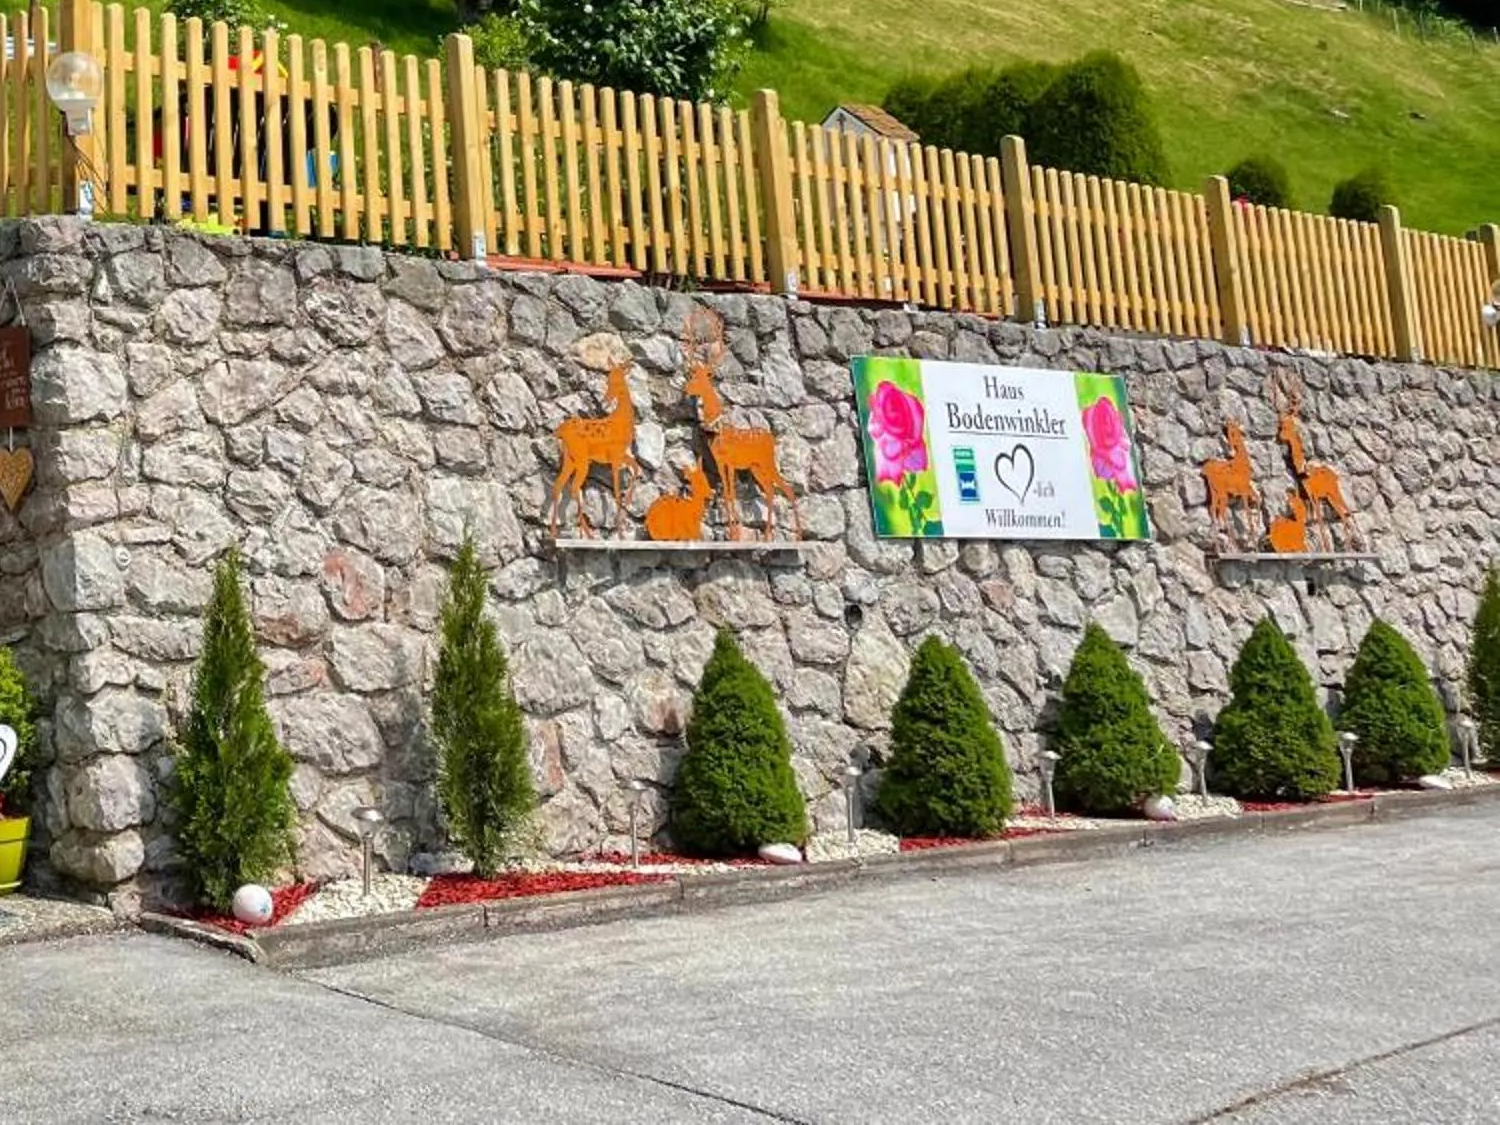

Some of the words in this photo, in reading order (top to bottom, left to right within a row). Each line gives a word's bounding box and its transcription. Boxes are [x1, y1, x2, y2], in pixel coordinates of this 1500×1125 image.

[983, 375, 1025, 400] Haus
[946, 402, 1066, 435] Bodenwinkler
[985, 508, 1067, 529] Willkommen!
